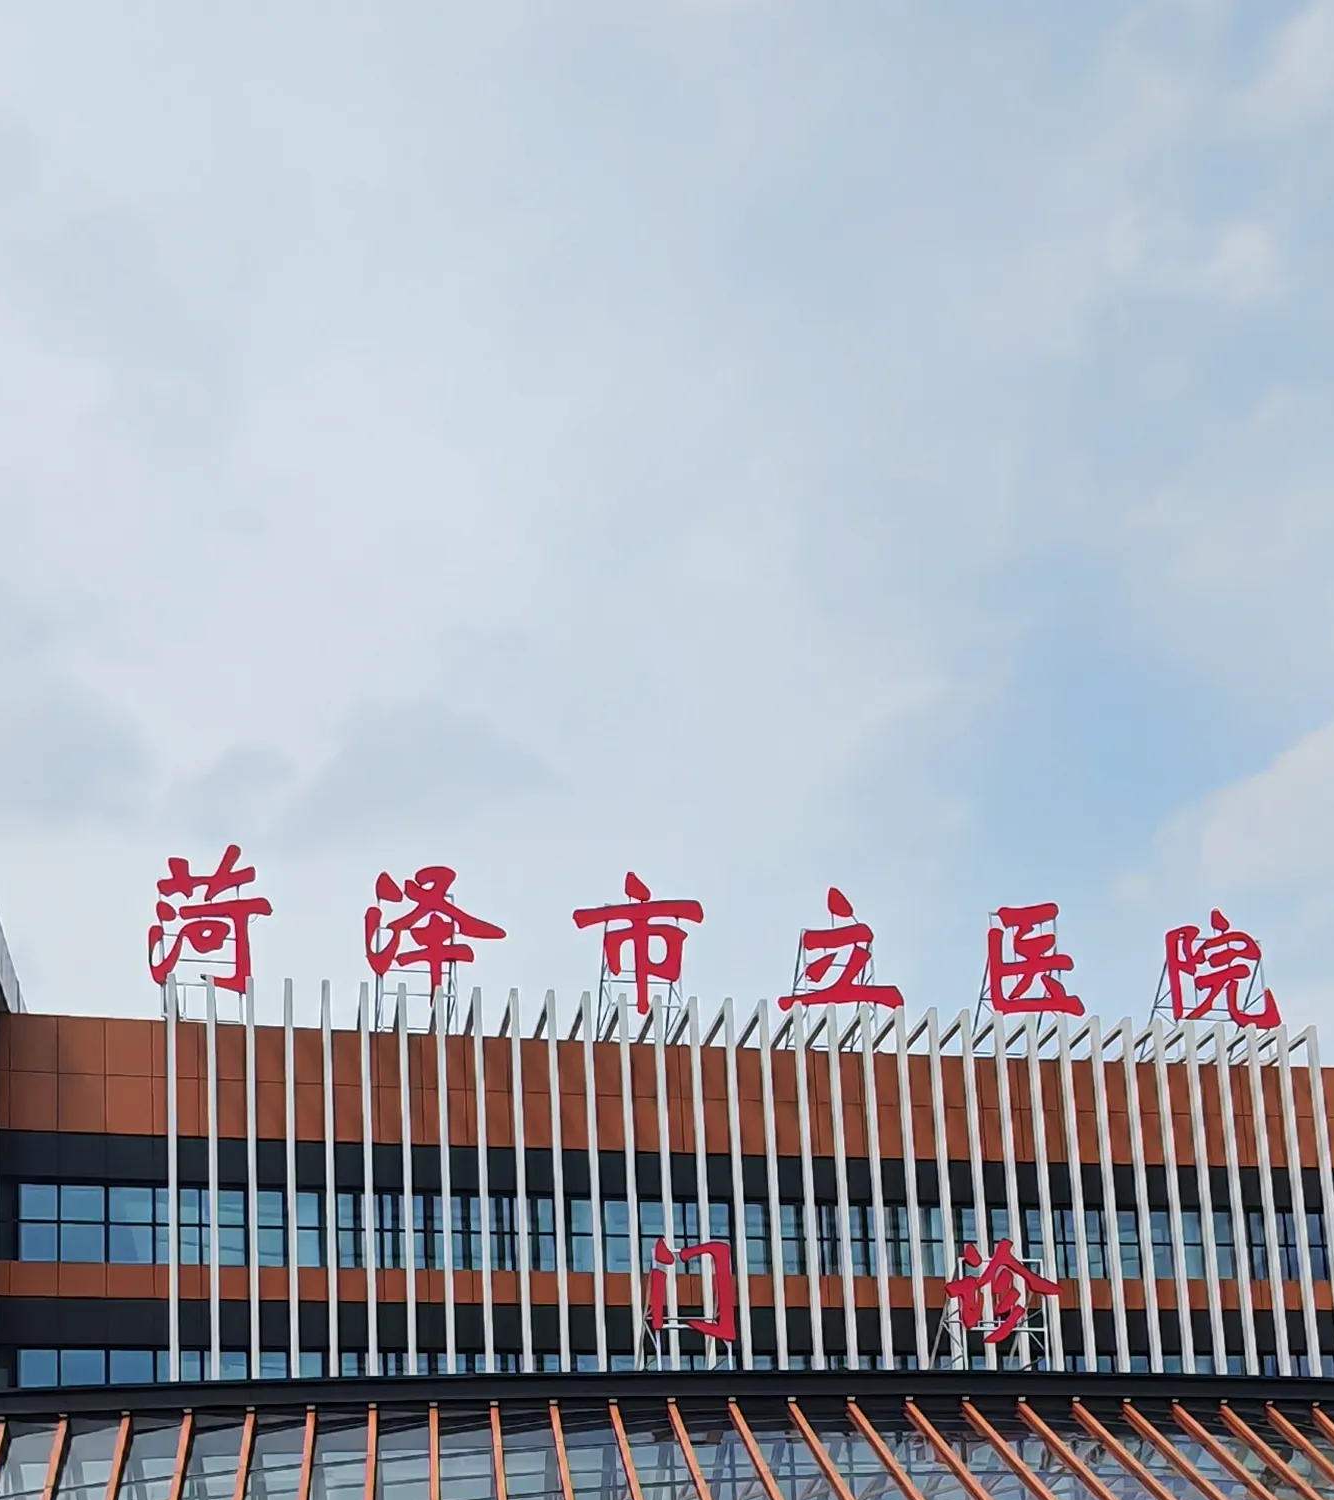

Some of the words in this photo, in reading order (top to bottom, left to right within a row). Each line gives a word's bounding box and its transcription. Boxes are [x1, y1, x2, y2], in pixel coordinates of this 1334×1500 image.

[148, 845, 1280, 1029] 菏泽市立医院
[649, 1238, 1063, 1344] 门诊
